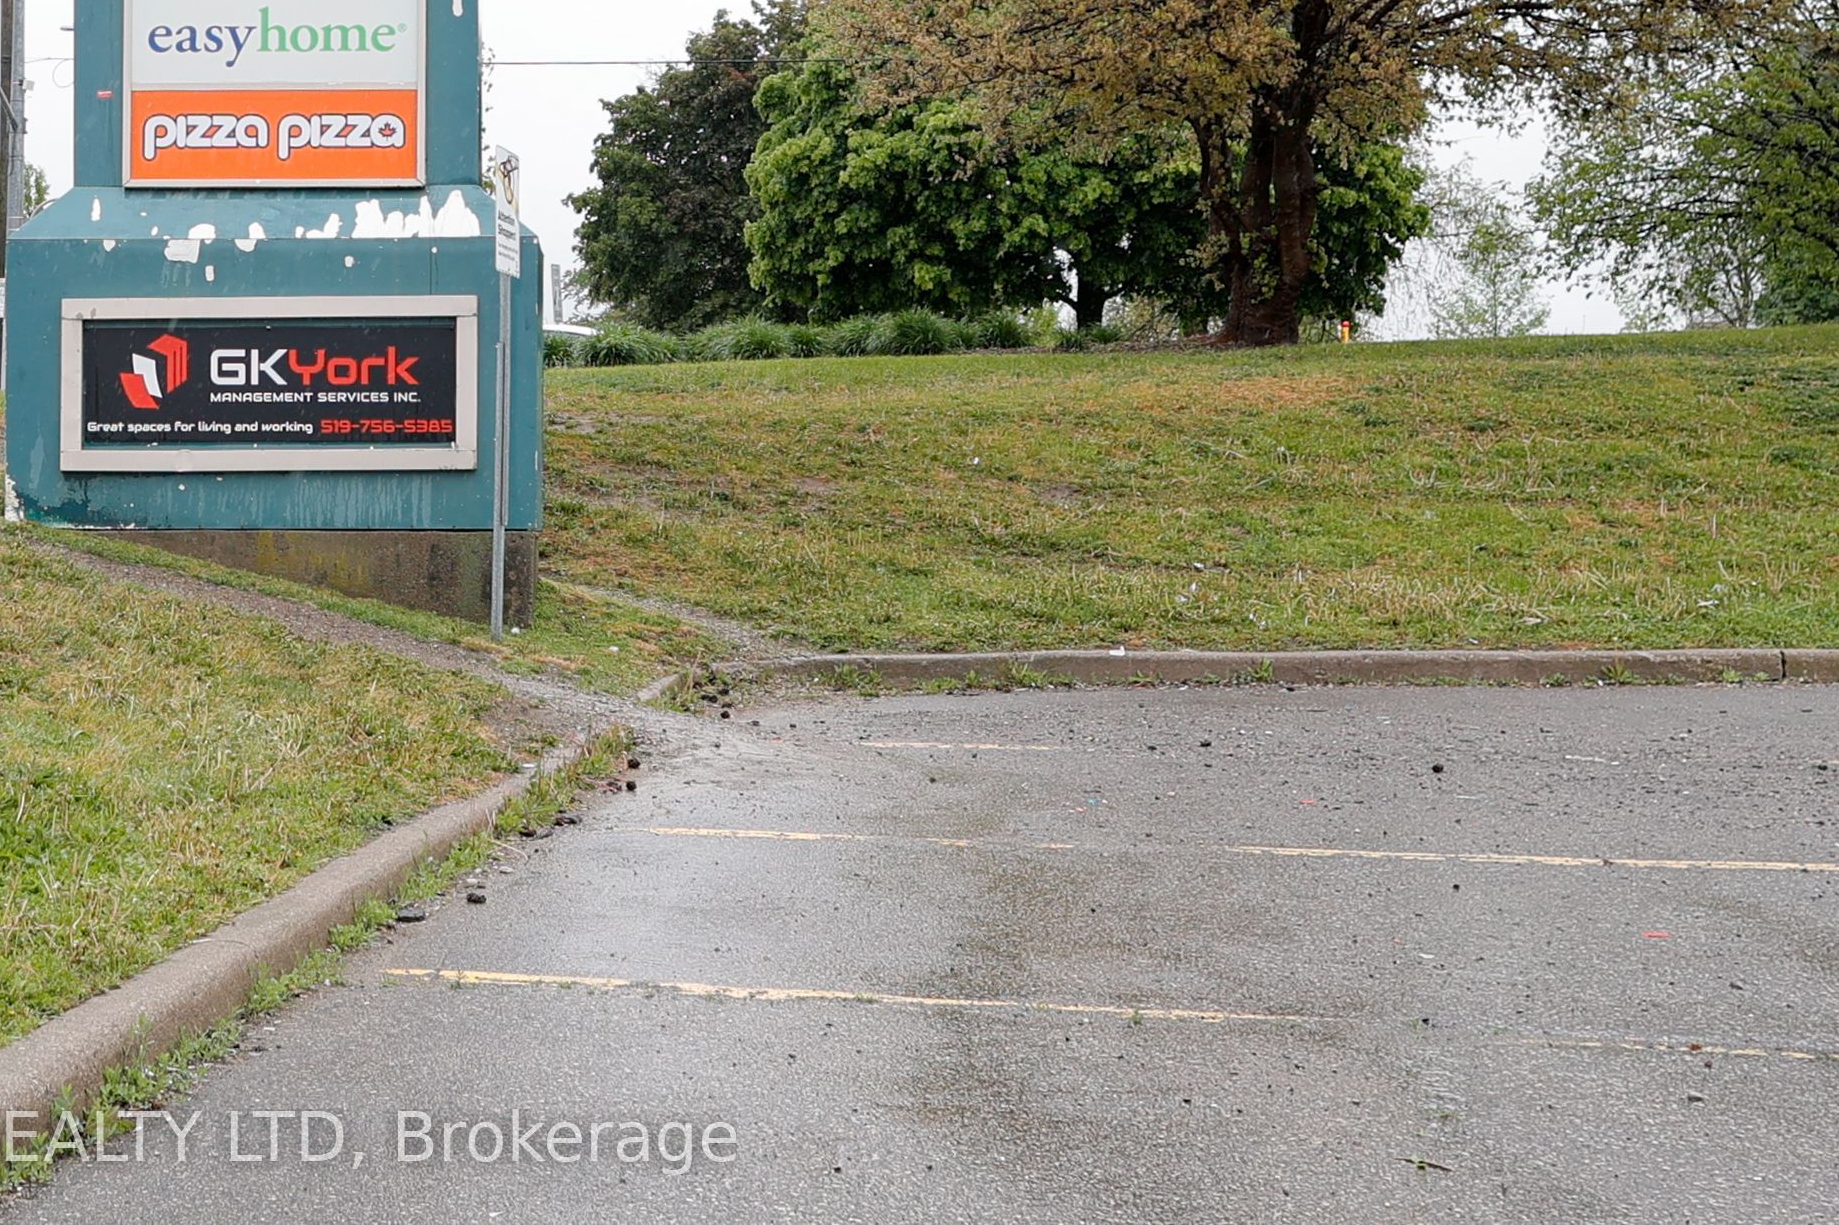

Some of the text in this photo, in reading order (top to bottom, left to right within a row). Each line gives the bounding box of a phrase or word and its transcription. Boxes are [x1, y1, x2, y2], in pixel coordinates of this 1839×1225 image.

[148, 6, 396, 67] easyhome
[143, 113, 406, 161] pizza pizza
[210, 345, 421, 385] GKYork
[209, 391, 421, 403] MANAGEMENT SERVICES INC.
[87, 420, 313, 434] Great spaces for living and working
[320, 419, 453, 433] 519-756-5385
